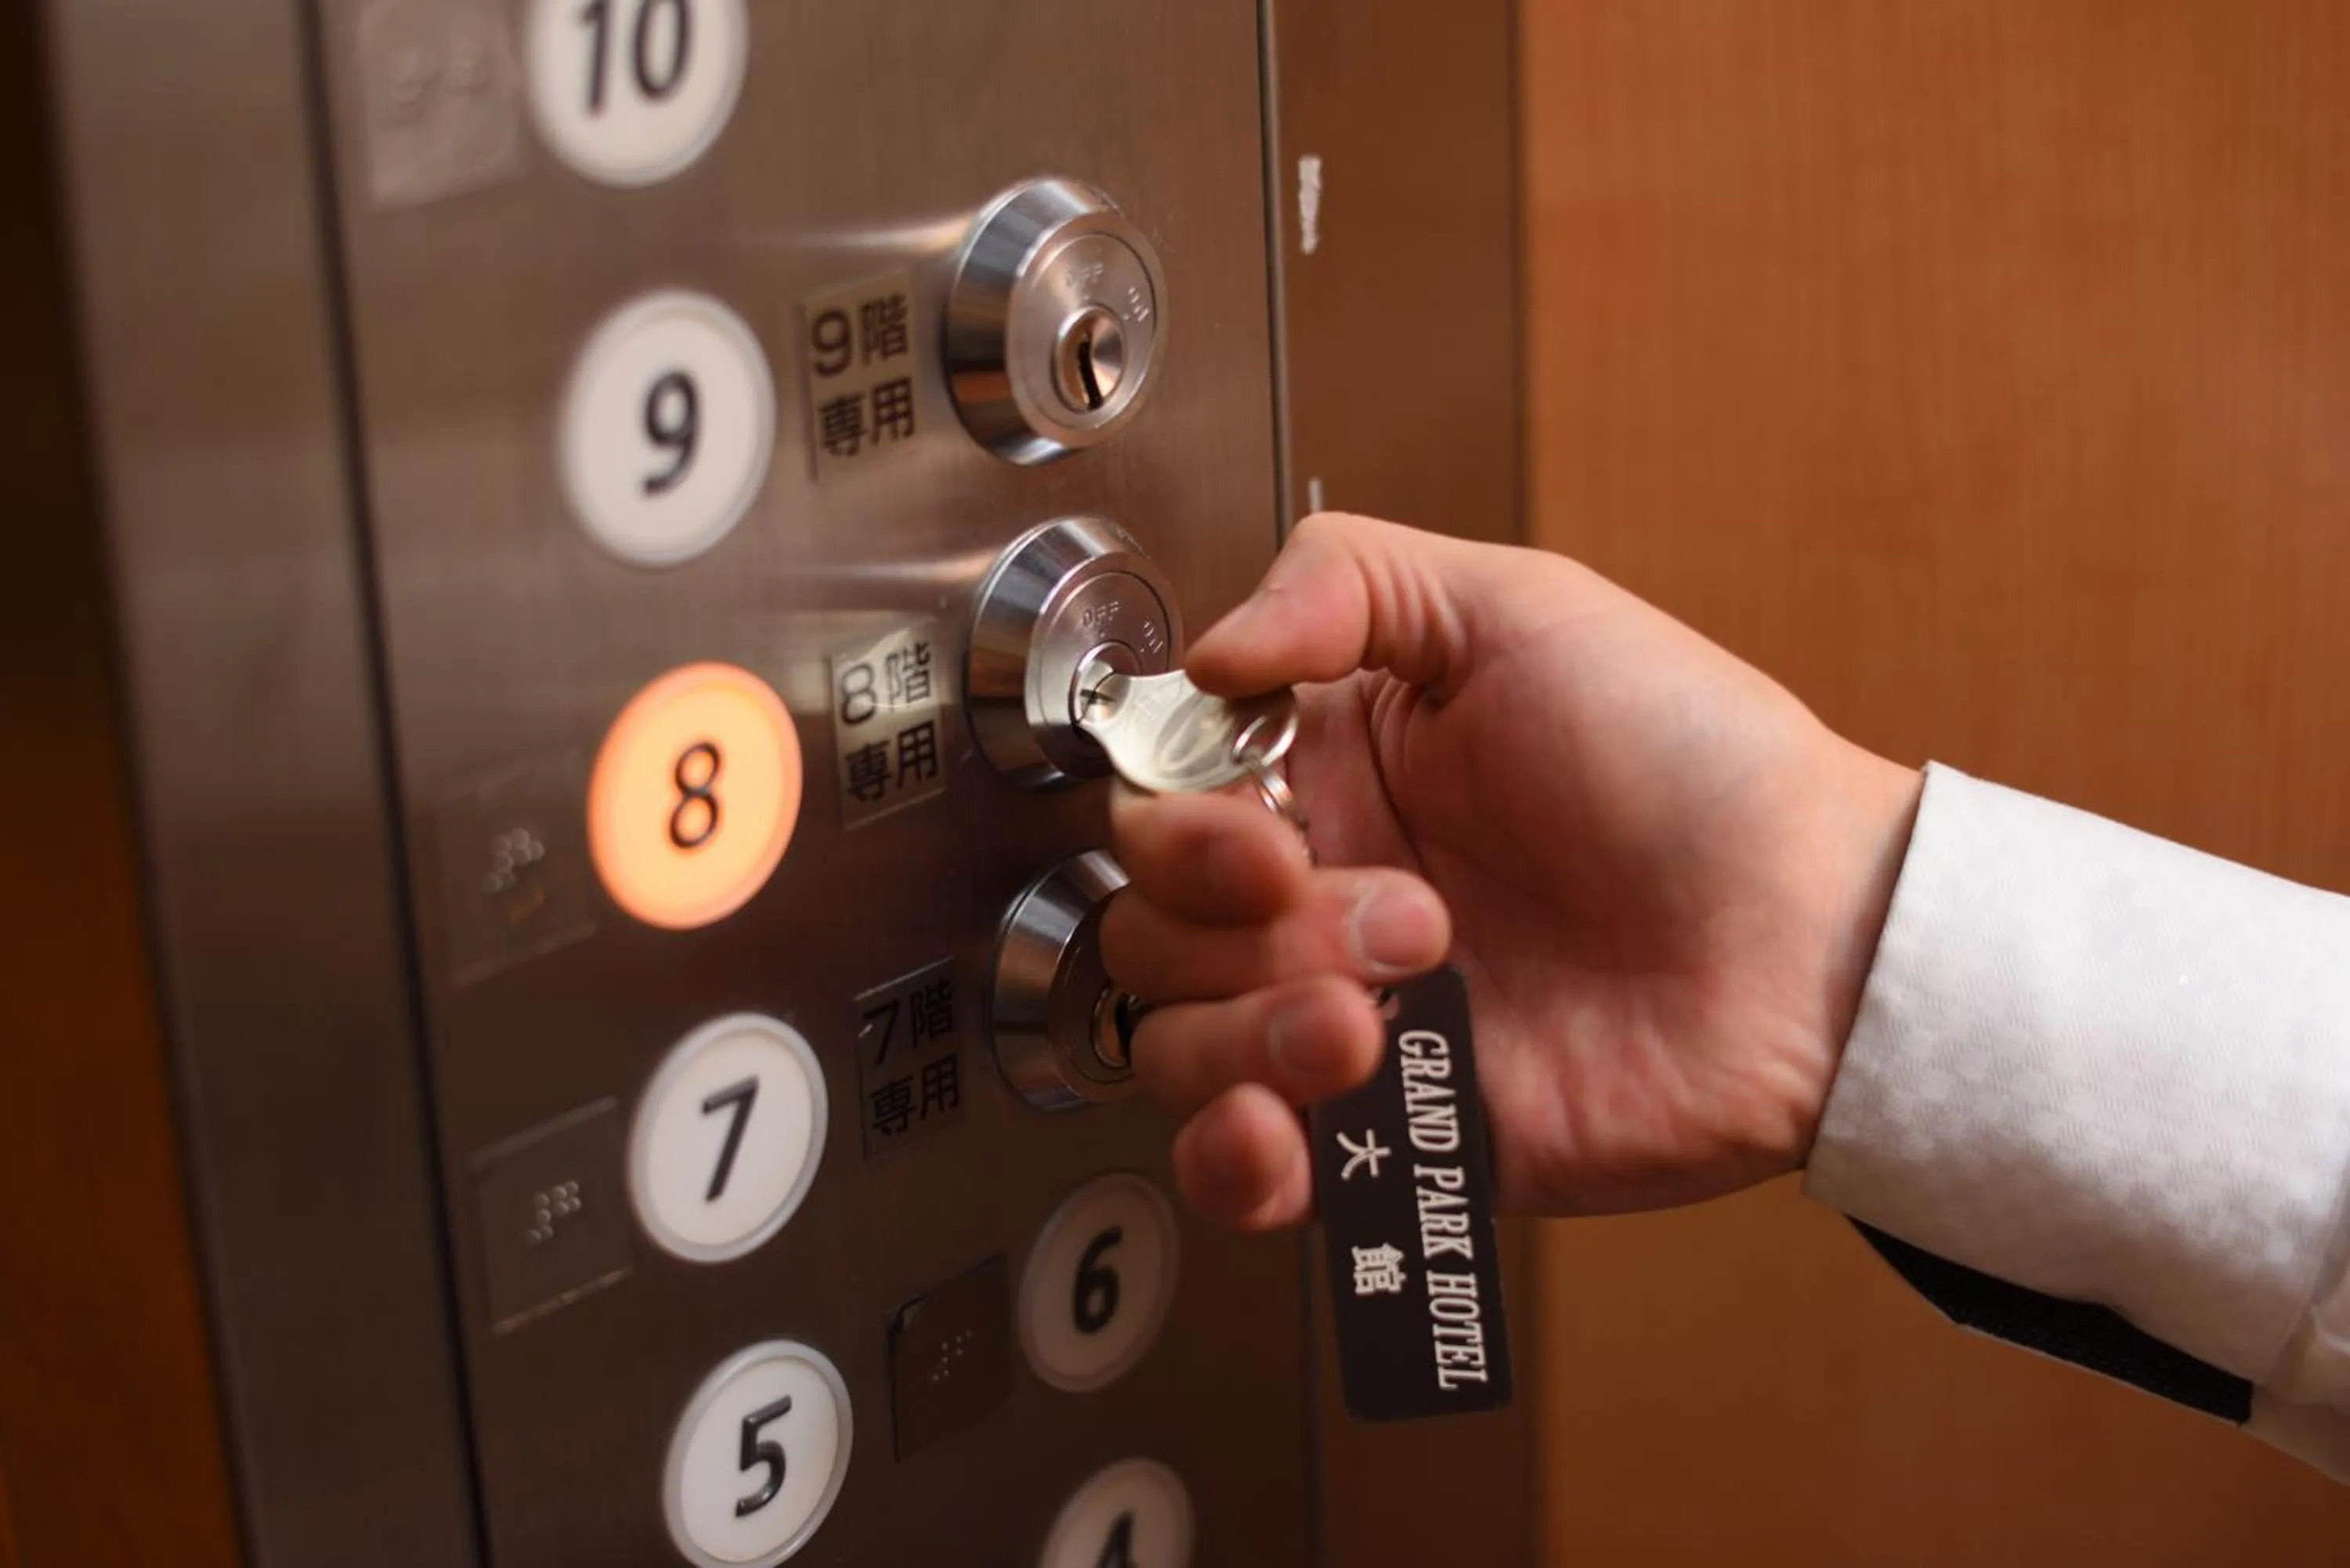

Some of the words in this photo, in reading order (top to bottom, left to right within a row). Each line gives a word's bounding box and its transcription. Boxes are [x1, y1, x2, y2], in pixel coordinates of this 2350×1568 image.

[580, 0, 691, 117] 10
[812, 292, 909, 378] 9階
[642, 370, 700, 499] 9
[818, 378, 914, 460] 専用
[840, 638, 933, 727] 8階
[670, 742, 720, 850] 8
[844, 720, 938, 803] 専用
[862, 978, 955, 1065] 7階
[702, 1075, 759, 1203] 7
[870, 1053, 960, 1136] 専用
[1398, 1029, 1460, 1154] GRAND
[1413, 1164, 1474, 1260] PARK
[1072, 1226, 1123, 1335] 6
[1426, 1270, 1488, 1390] HOTEL
[734, 1394, 792, 1518] 5
